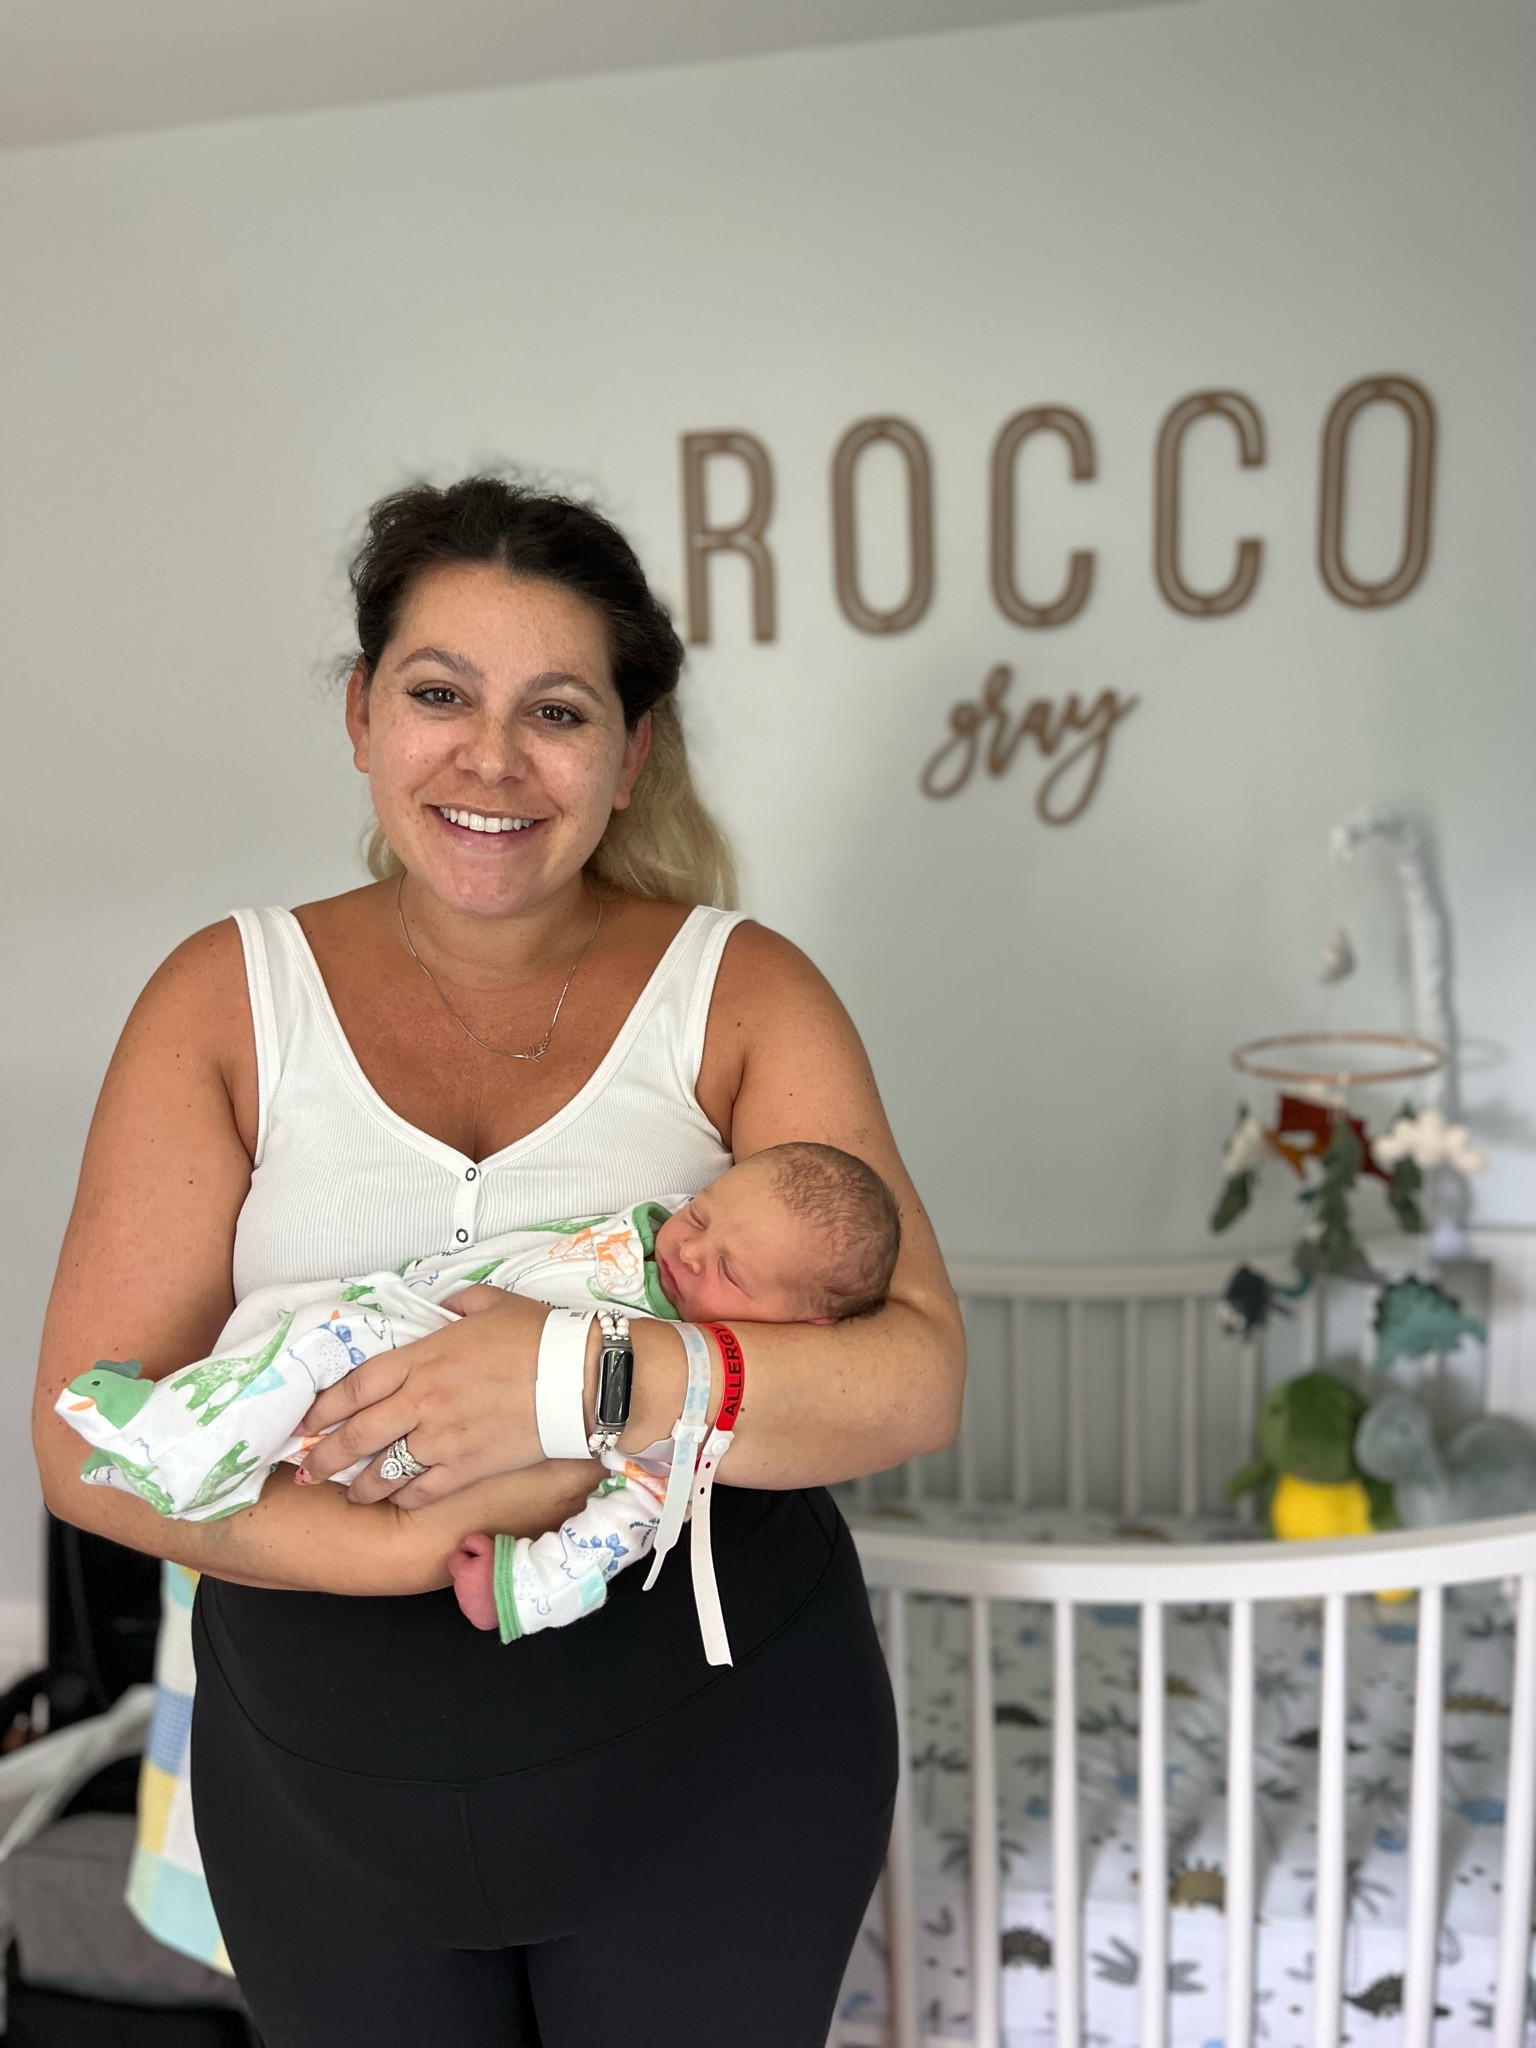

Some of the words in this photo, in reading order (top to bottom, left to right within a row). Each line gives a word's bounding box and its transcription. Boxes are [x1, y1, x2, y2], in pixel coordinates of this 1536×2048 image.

[678, 373, 1439, 647] ROCCO
[920, 662, 1140, 827] gray
[712, 1325, 742, 1417] ALLERGY
